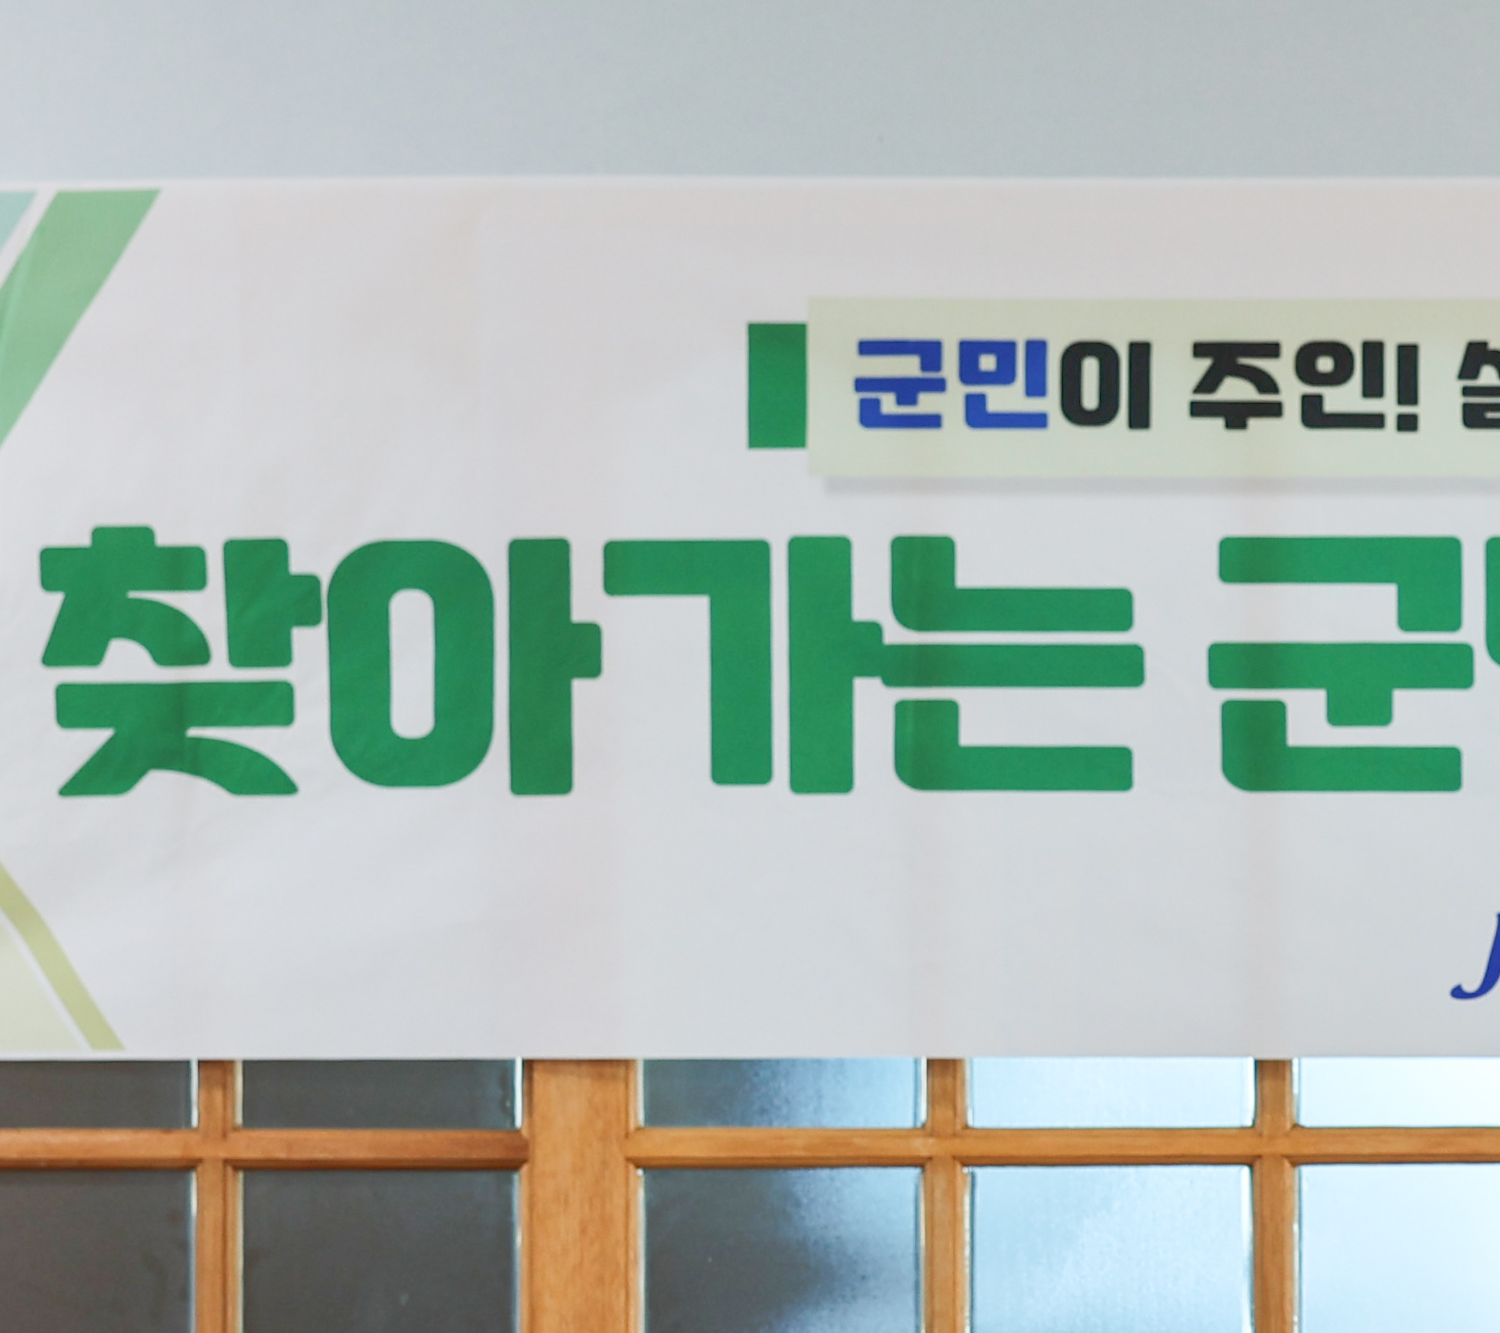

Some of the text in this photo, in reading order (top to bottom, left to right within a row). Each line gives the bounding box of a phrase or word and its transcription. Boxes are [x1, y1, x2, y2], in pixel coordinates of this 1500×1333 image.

[853, 338, 1152, 431] 군민이
[1188, 338, 1419, 432] 주인!
[38, 524, 1146, 796] 찾아가는
